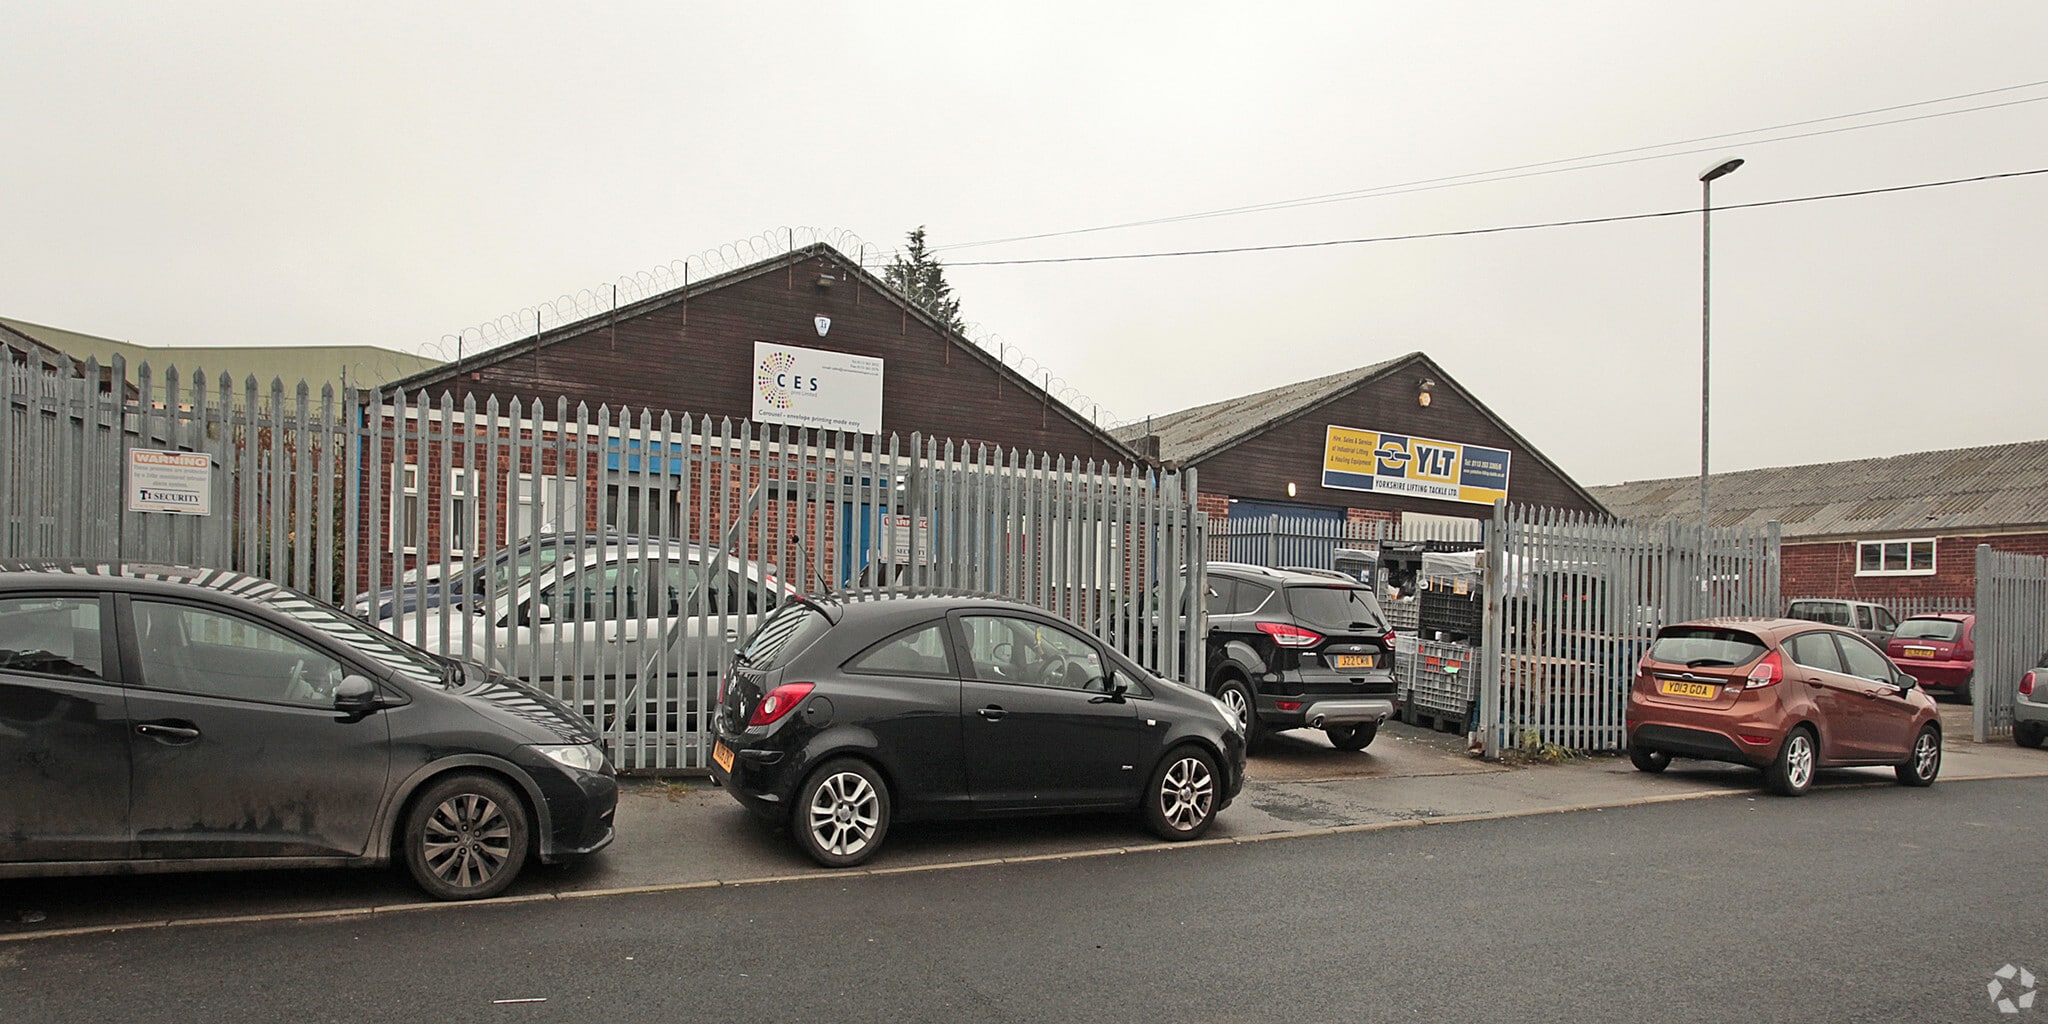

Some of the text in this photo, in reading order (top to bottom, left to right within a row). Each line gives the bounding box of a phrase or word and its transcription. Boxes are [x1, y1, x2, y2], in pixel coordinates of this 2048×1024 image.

[758, 409, 782, 418] Carousel
[812, 416, 832, 424] printing
[136, 454, 206, 466] WARNING
[1351, 458, 1371, 466] Equipment
[1416, 445, 1456, 477] YLT
[1376, 479, 1406, 491] YORKSHIRE
[1406, 482, 1428, 493] LIFTING
[1429, 485, 1447, 495] TACKLE
[154, 492, 199, 502] SECURITY
[1669, 682, 1707, 696] YD13 GOA
